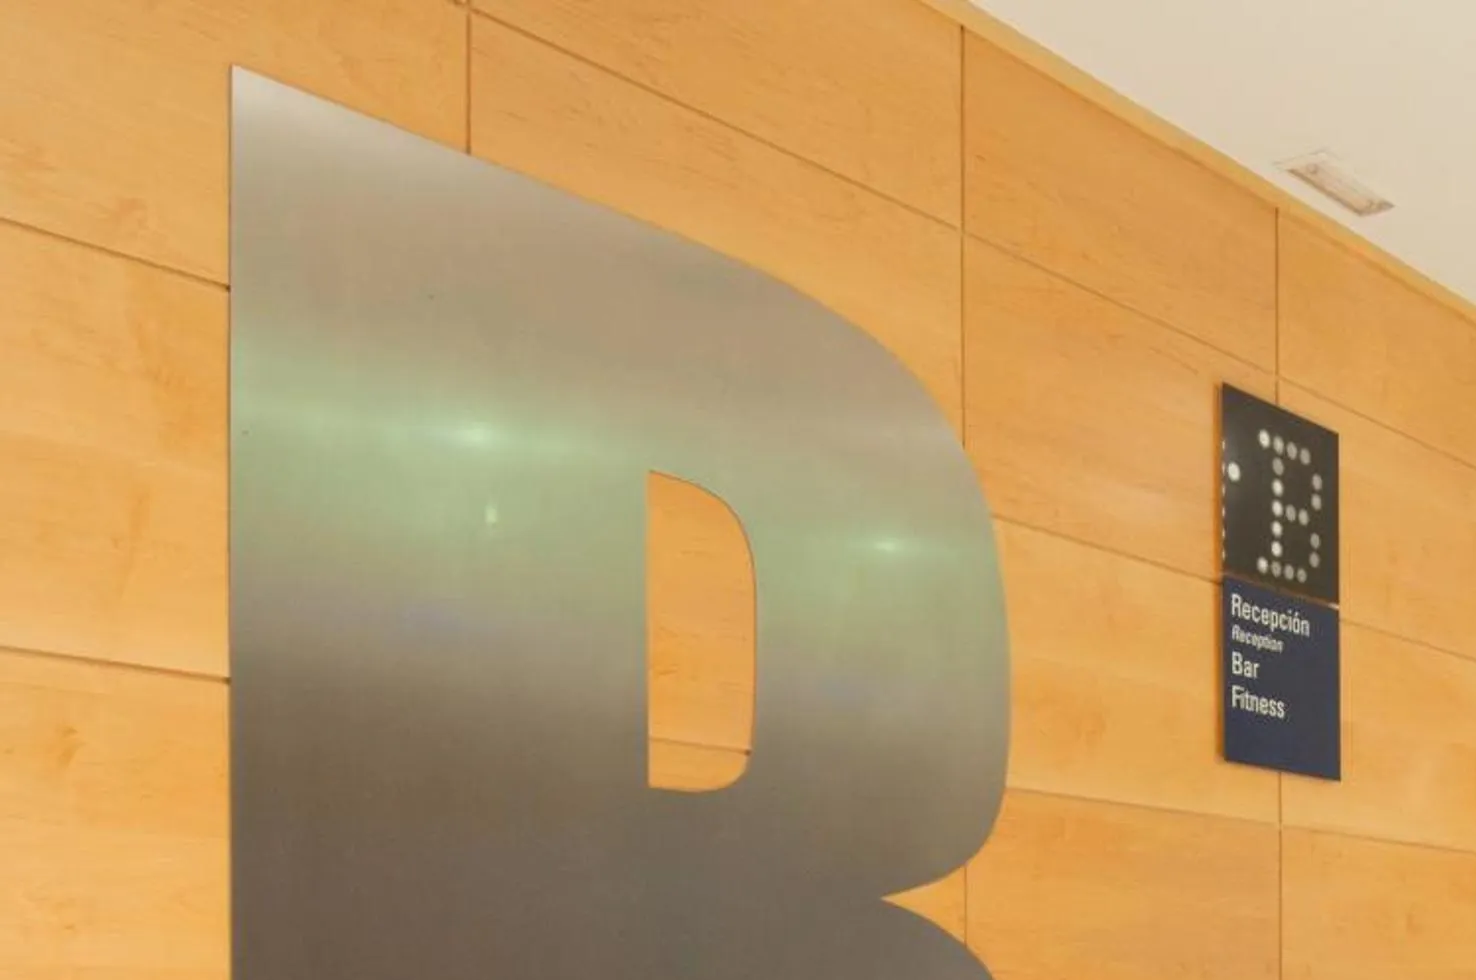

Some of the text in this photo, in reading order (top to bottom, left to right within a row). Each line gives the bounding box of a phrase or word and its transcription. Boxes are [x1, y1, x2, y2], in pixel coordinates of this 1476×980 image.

[1231, 593, 1310, 637] Recepción
[1231, 623, 1284, 653] Reception
[1231, 650, 1260, 678] Bar
[1231, 684, 1285, 719] Fitness
